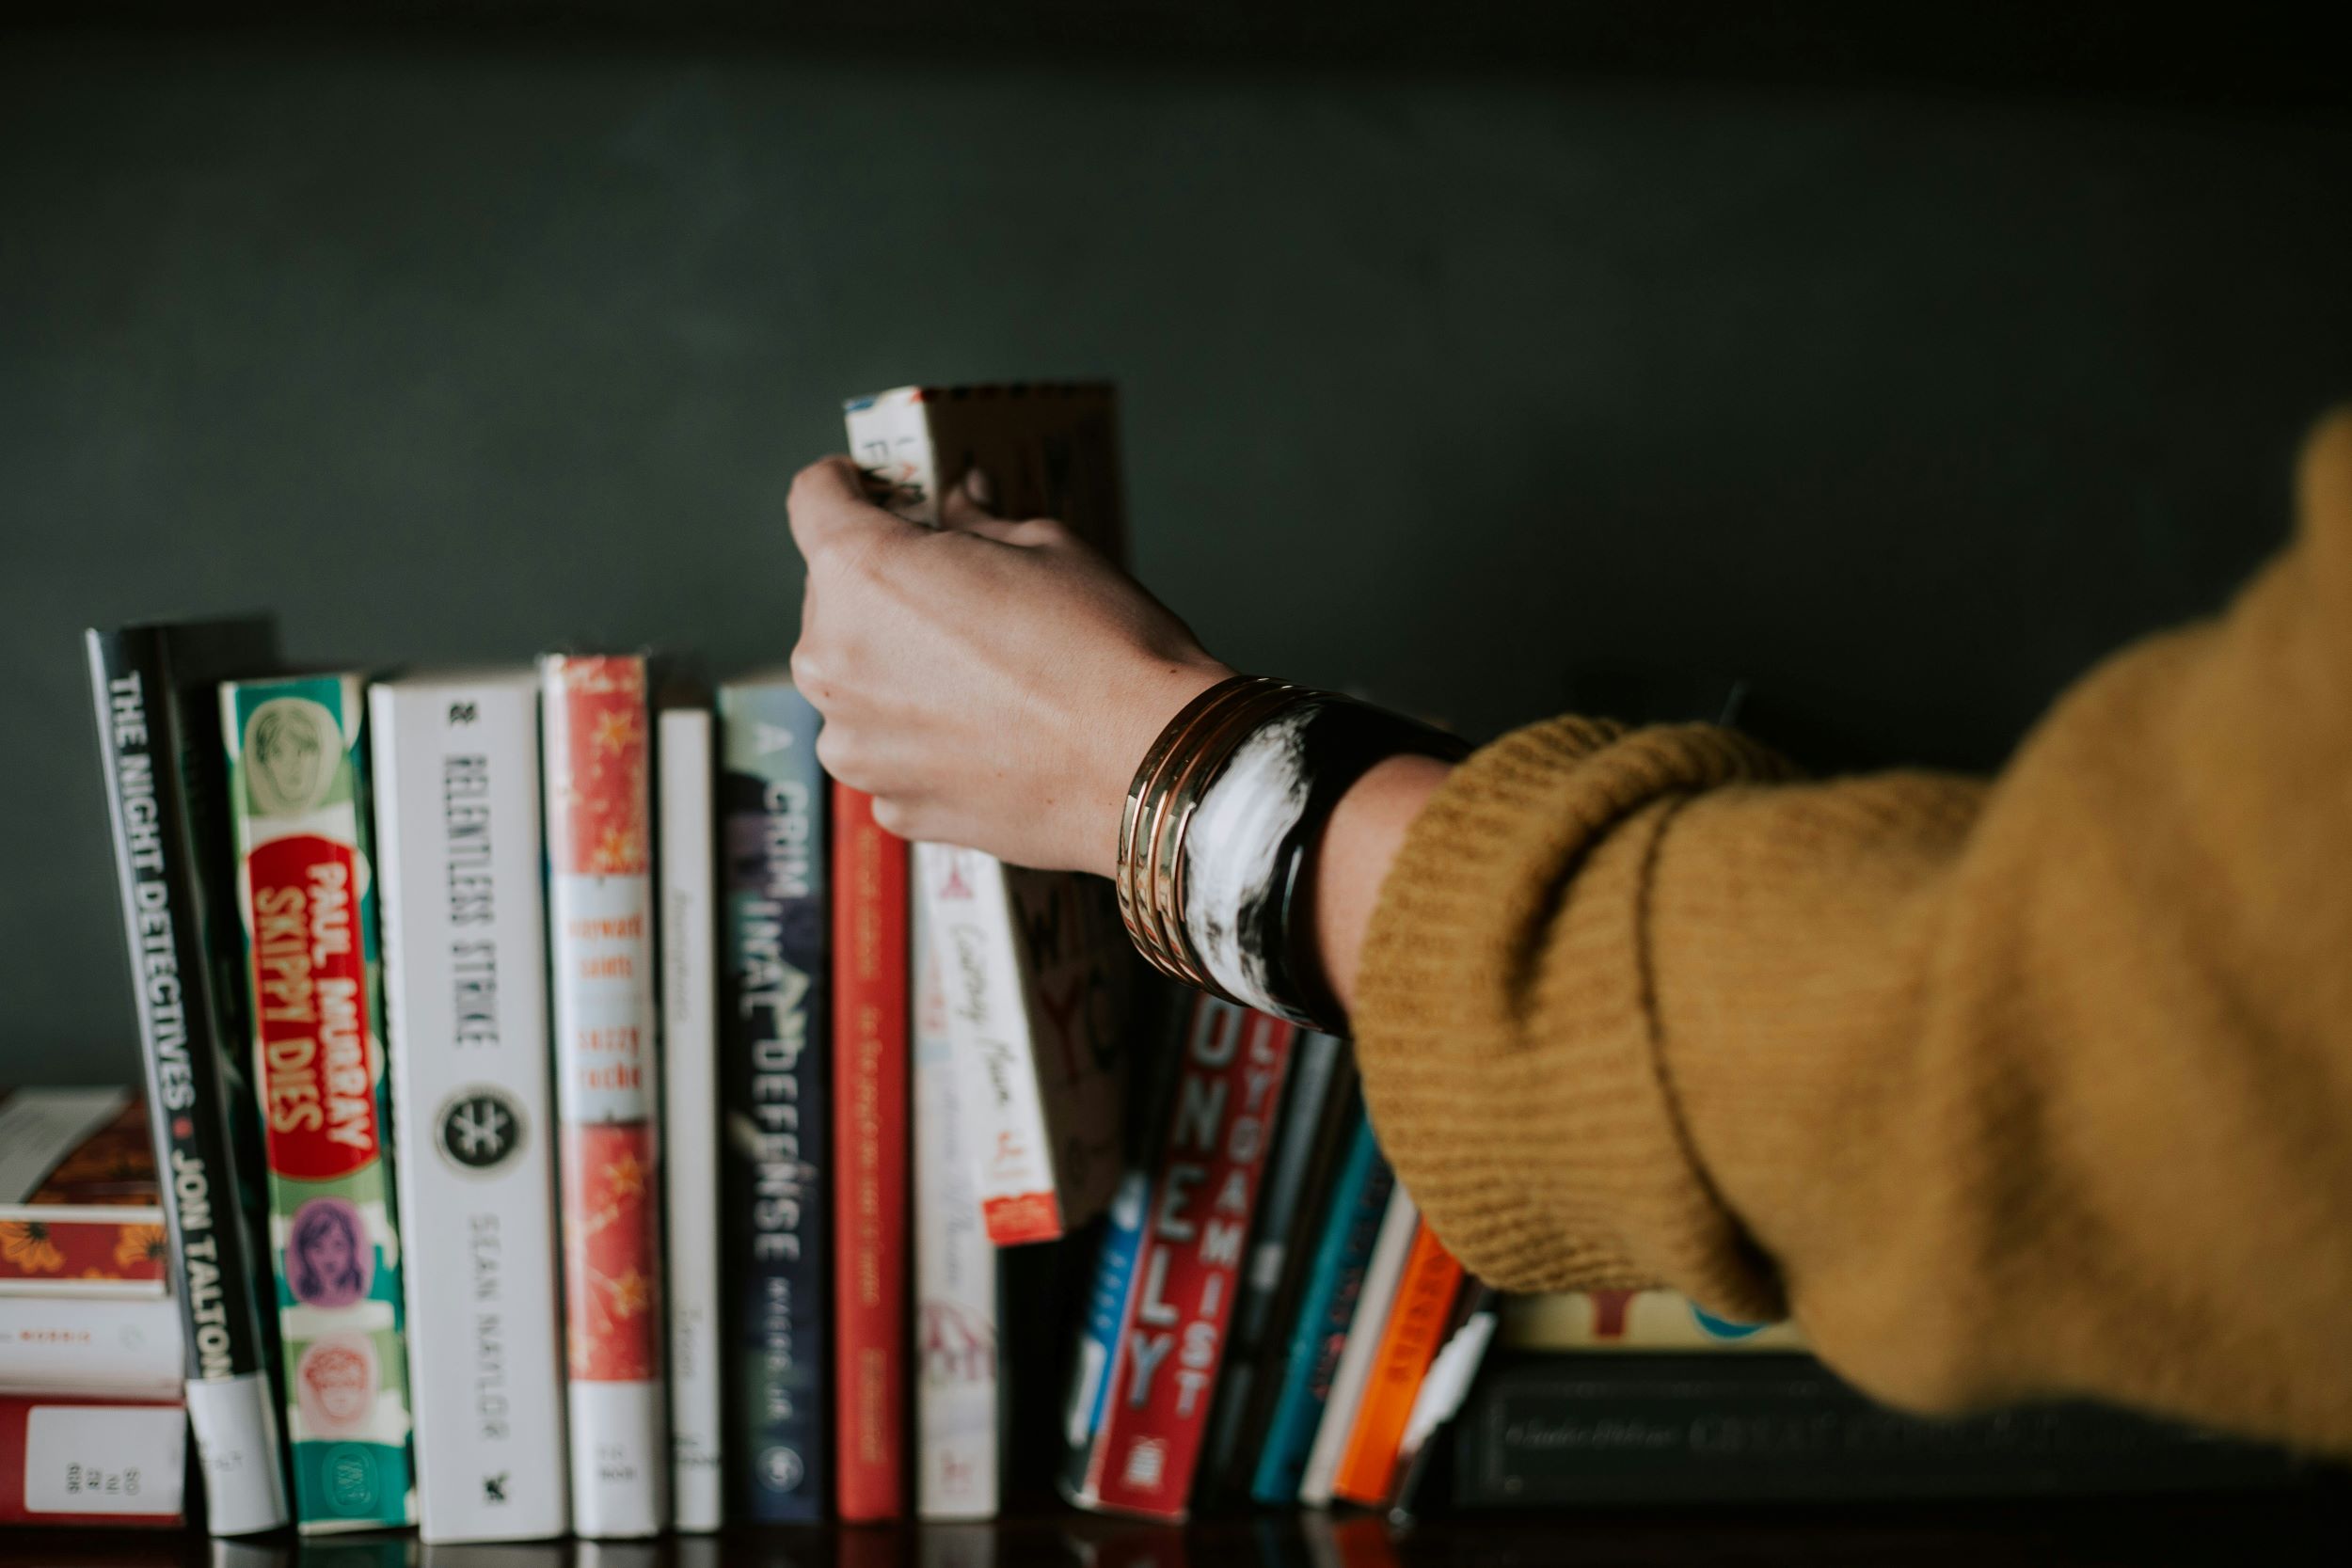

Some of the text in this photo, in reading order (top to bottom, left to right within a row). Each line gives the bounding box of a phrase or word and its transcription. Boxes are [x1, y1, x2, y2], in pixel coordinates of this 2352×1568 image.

[754, 722, 794, 752] A
[108, 671, 197, 1111] THE NIGHT DETECTIVES
[256, 886, 326, 1134] SKIPPY DIES
[306, 861, 373, 1151] PAUL MURRAY
[444, 755, 500, 1046] RELENTLESS STRIKE
[172, 1148, 235, 1383] JON TALTON
[753, 1037, 802, 1261] DEFENSE
[1126, 990, 1245, 1408] ONELY
[1173, 1014, 1282, 1418] LYGAMIST
